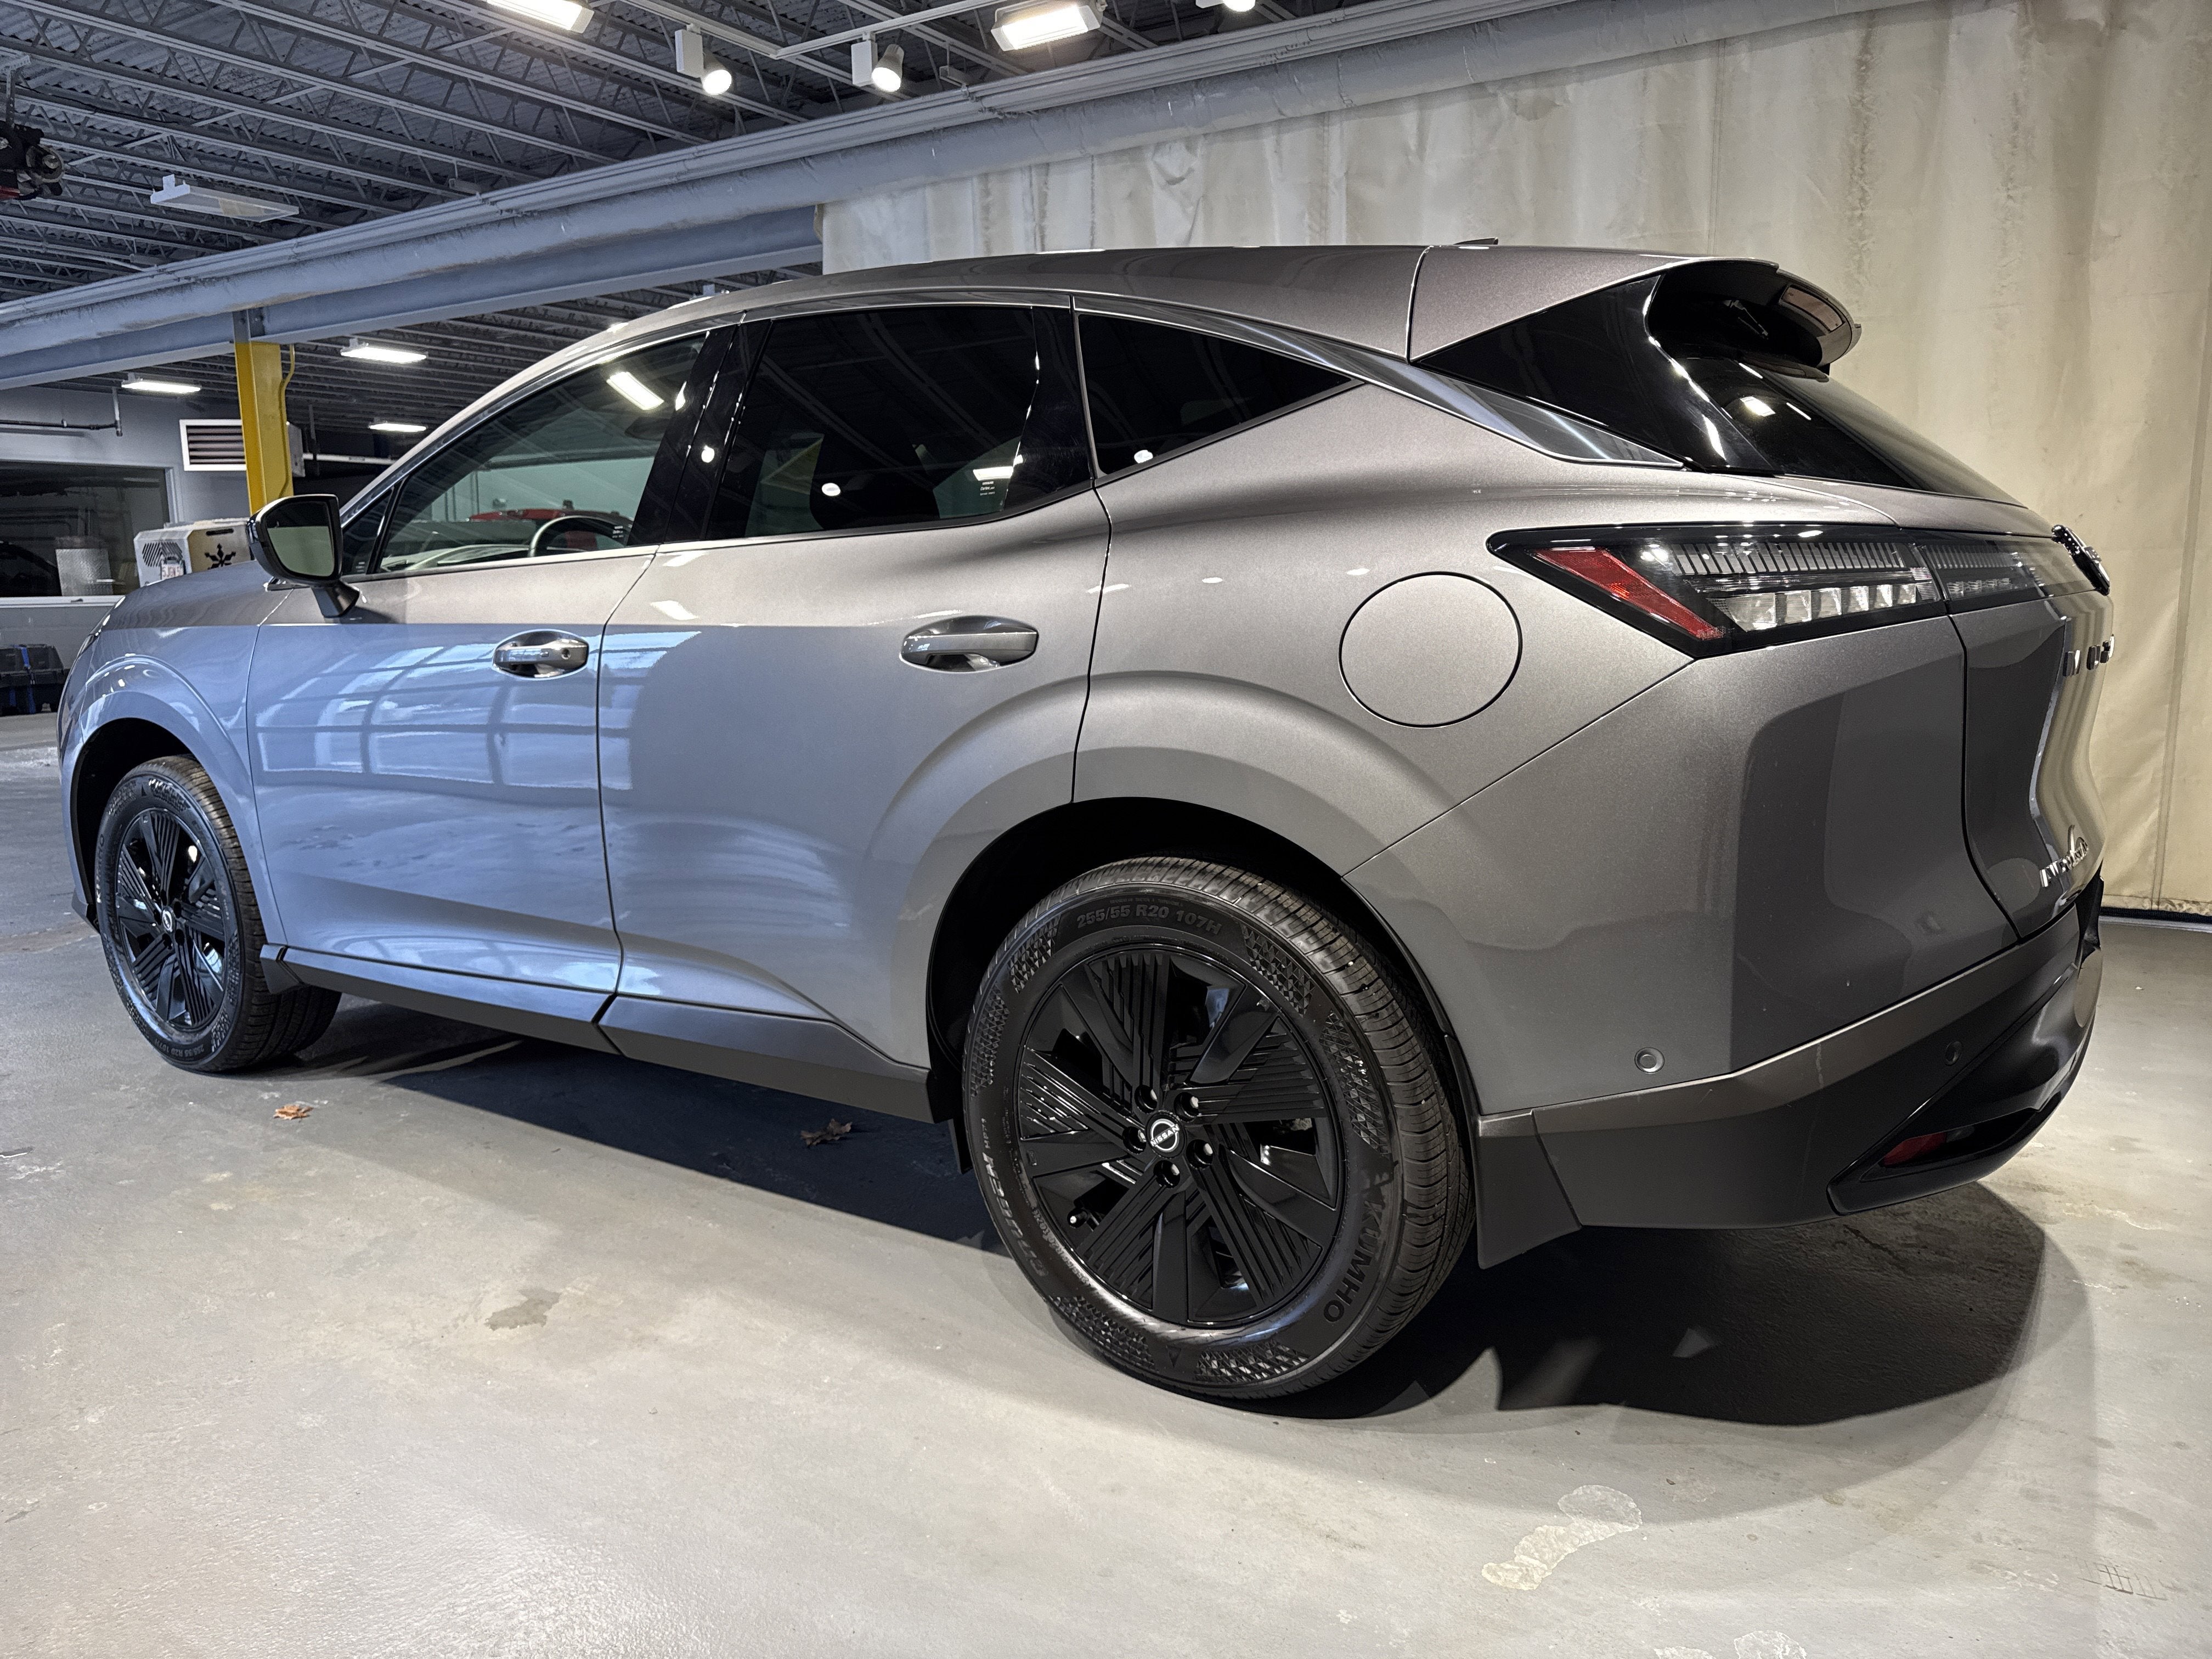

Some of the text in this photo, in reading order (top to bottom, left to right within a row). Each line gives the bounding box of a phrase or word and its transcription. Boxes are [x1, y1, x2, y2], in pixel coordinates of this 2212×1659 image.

[1076, 904, 1222, 935] 255/55 R20 107H
[1150, 1124, 1180, 1147] NISSAN
[1323, 1200, 1384, 1323] KUMHO
